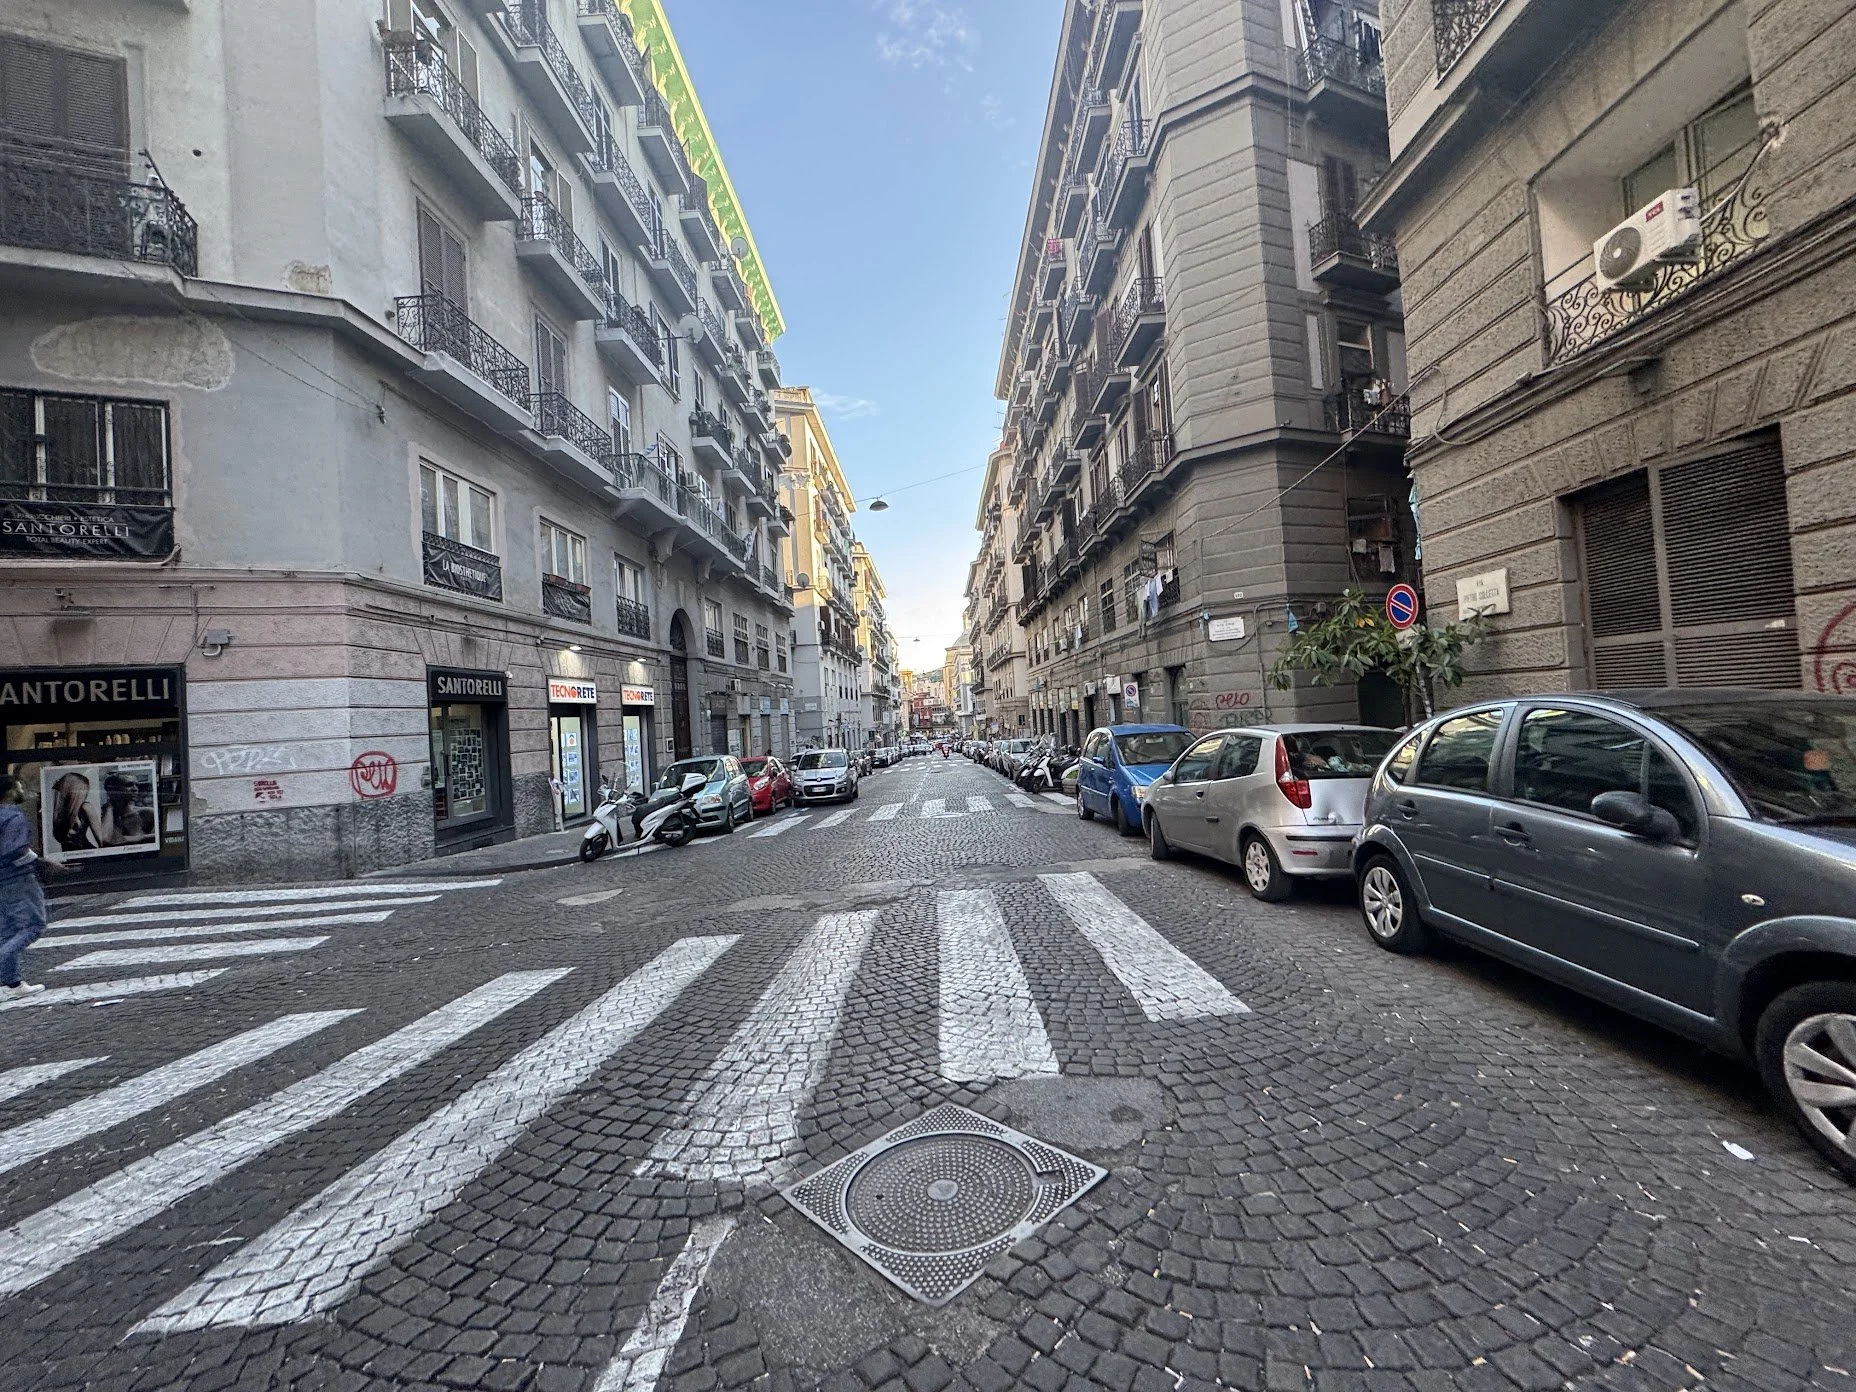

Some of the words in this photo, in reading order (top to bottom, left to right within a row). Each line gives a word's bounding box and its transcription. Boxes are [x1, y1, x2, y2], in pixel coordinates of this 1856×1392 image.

[2, 521, 129, 537] SANTORELLI
[26, 535, 50, 543] TOTAL
[442, 559, 450, 571] LA
[450, 562, 487, 583] BIOSTHETIQUE
[437, 676, 502, 696] SANTORELLI
[550, 684, 595, 699] TECNORETE
[623, 689, 653, 702] TECNORETE
